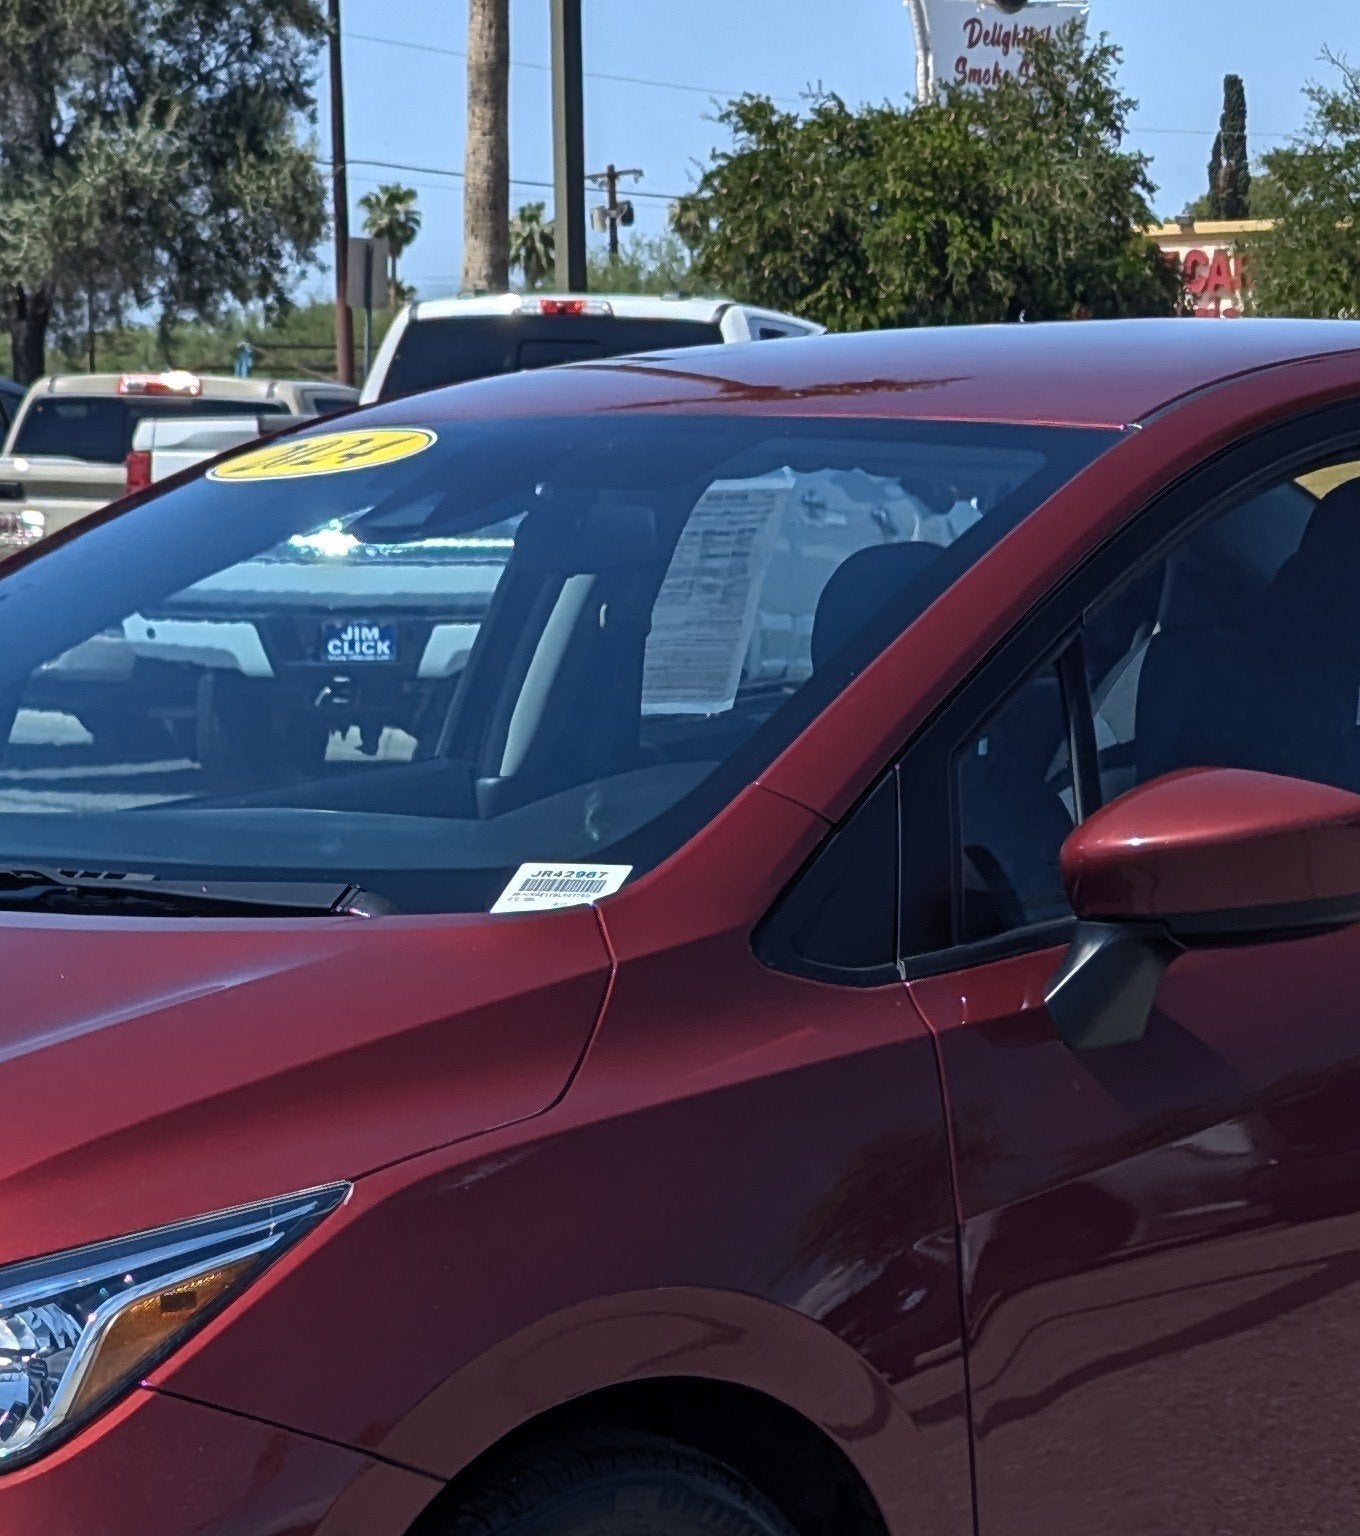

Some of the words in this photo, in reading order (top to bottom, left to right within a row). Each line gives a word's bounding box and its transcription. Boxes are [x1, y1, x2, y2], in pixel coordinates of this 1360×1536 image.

[963, 17, 1052, 56] Delightl
[341, 626, 380, 640] JIM
[327, 639, 391, 655] CLICK
